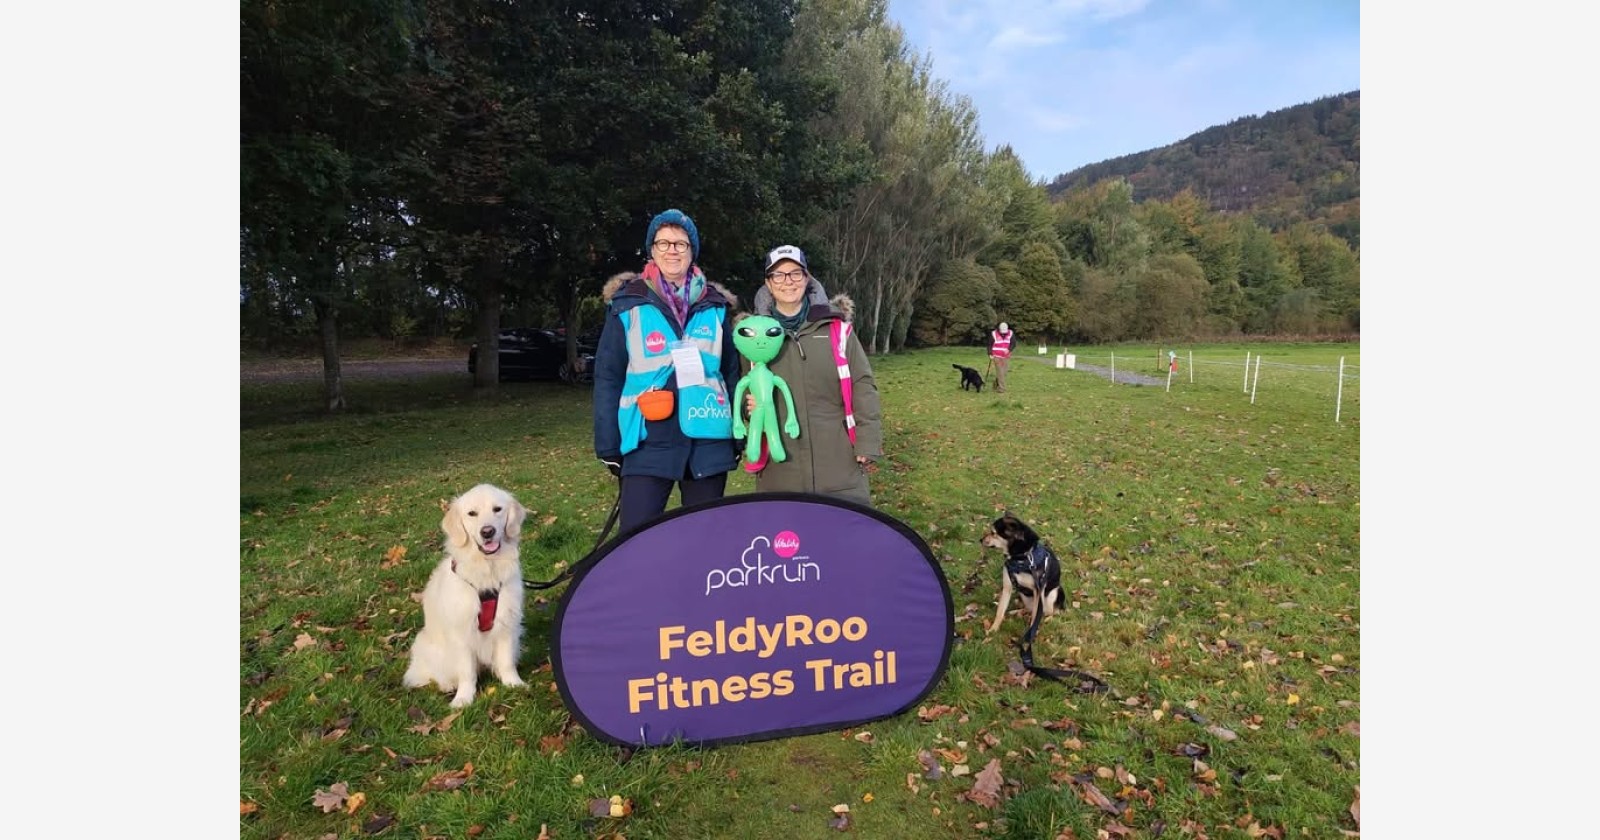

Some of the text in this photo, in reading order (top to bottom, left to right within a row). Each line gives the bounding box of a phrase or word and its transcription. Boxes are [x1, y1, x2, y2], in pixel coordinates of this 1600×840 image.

[705, 535, 821, 596] parkrun
[774, 537, 799, 549] Vitality
[658, 614, 868, 660] FeldyRoo
[628, 650, 897, 714] Fitness Trail
